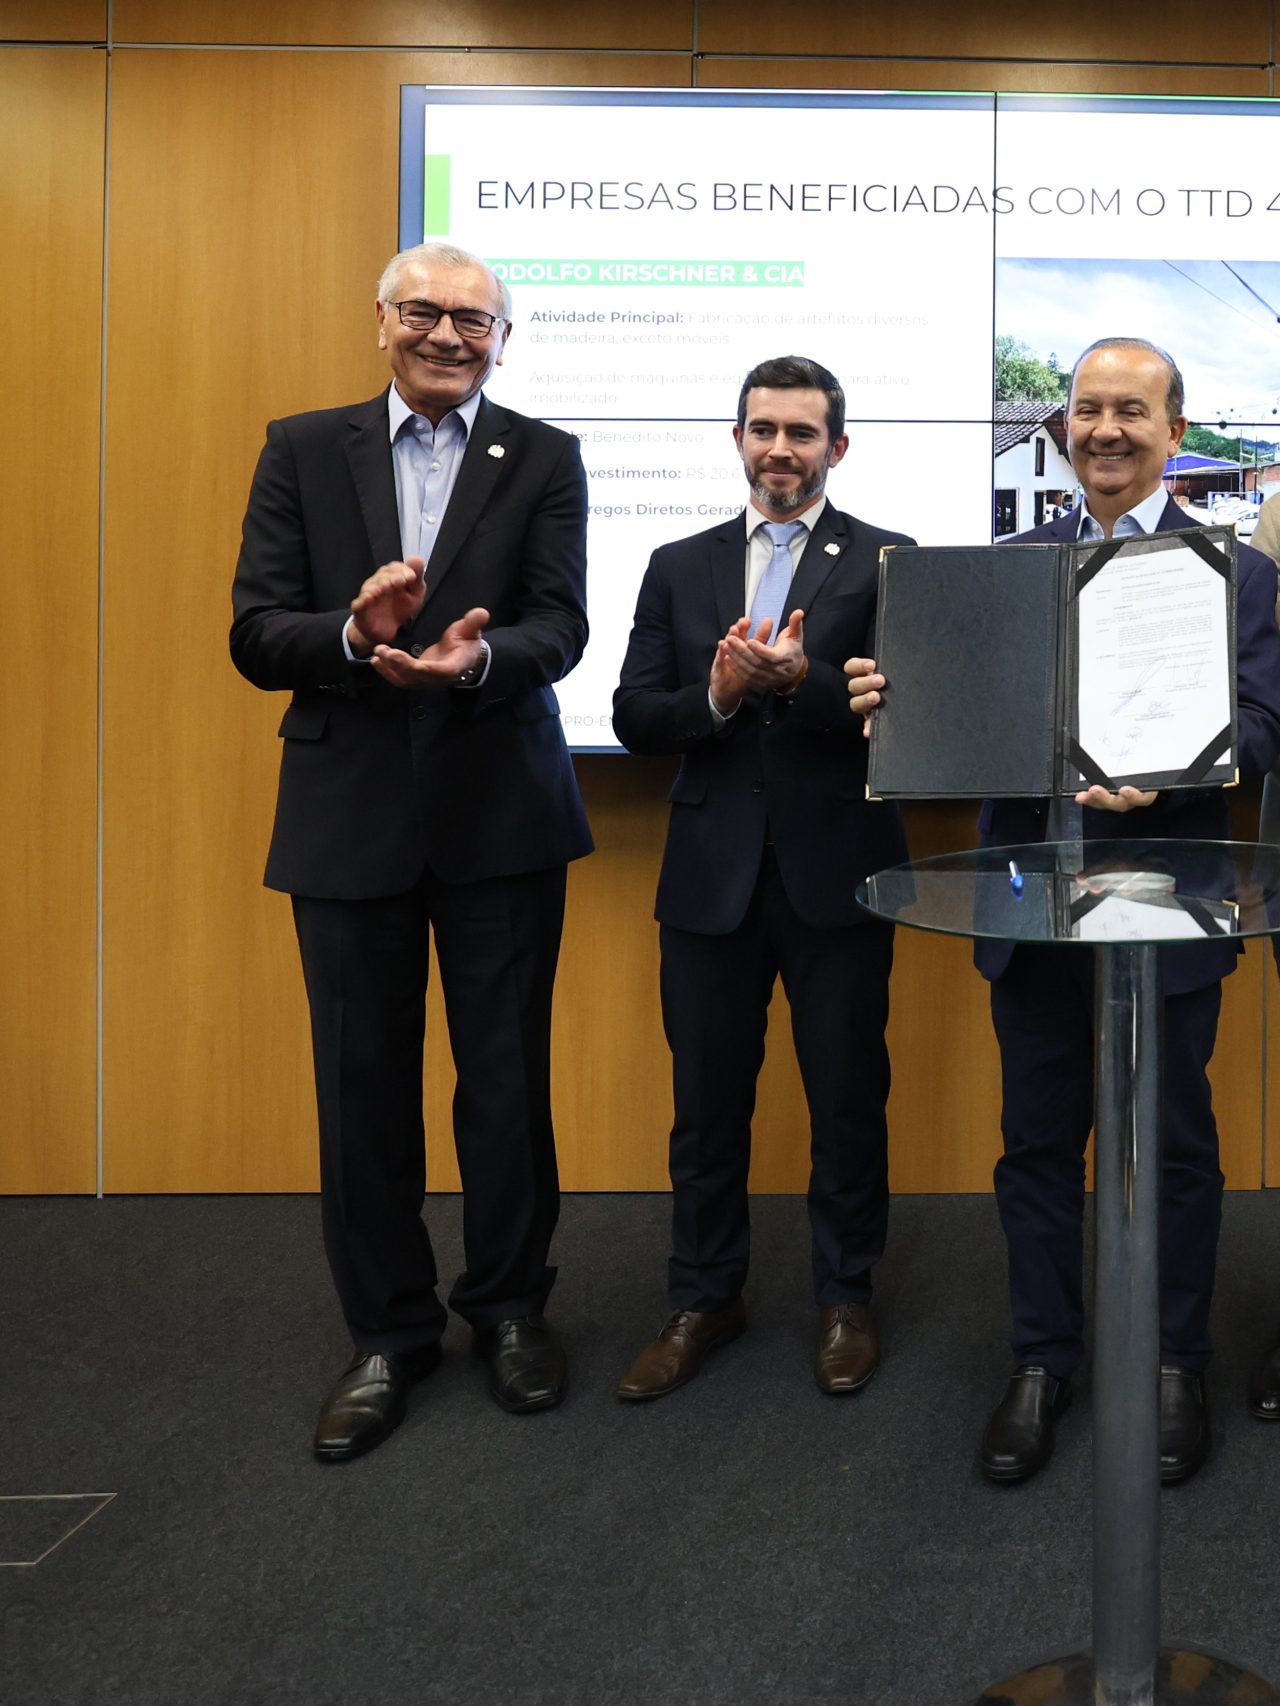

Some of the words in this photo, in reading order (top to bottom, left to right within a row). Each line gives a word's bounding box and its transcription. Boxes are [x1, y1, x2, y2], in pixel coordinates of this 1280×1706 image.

[478, 180, 698, 211] EMPRESAS
[713, 182, 1015, 215] BENEFICIADAS
[1028, 186, 1121, 216] COM
[1136, 188, 1166, 217] O
[1177, 189, 1253, 218] TTD
[490, 262, 593, 281] ODOLFO
[599, 263, 735, 282] KIRSCHNER
[742, 264, 758, 282] &
[764, 265, 804, 283] CIA
[529, 310, 606, 323] Atividade
[610, 310, 684, 326] Principal:
[529, 331, 550, 344] de
[593, 430, 662, 443] Benedito
[666, 431, 705, 443] Novo
[588, 466, 682, 480] vestimento:
[588, 505, 632, 519] regos
[636, 503, 694, 516] Diretos
[697, 503, 744, 517] Gerad
